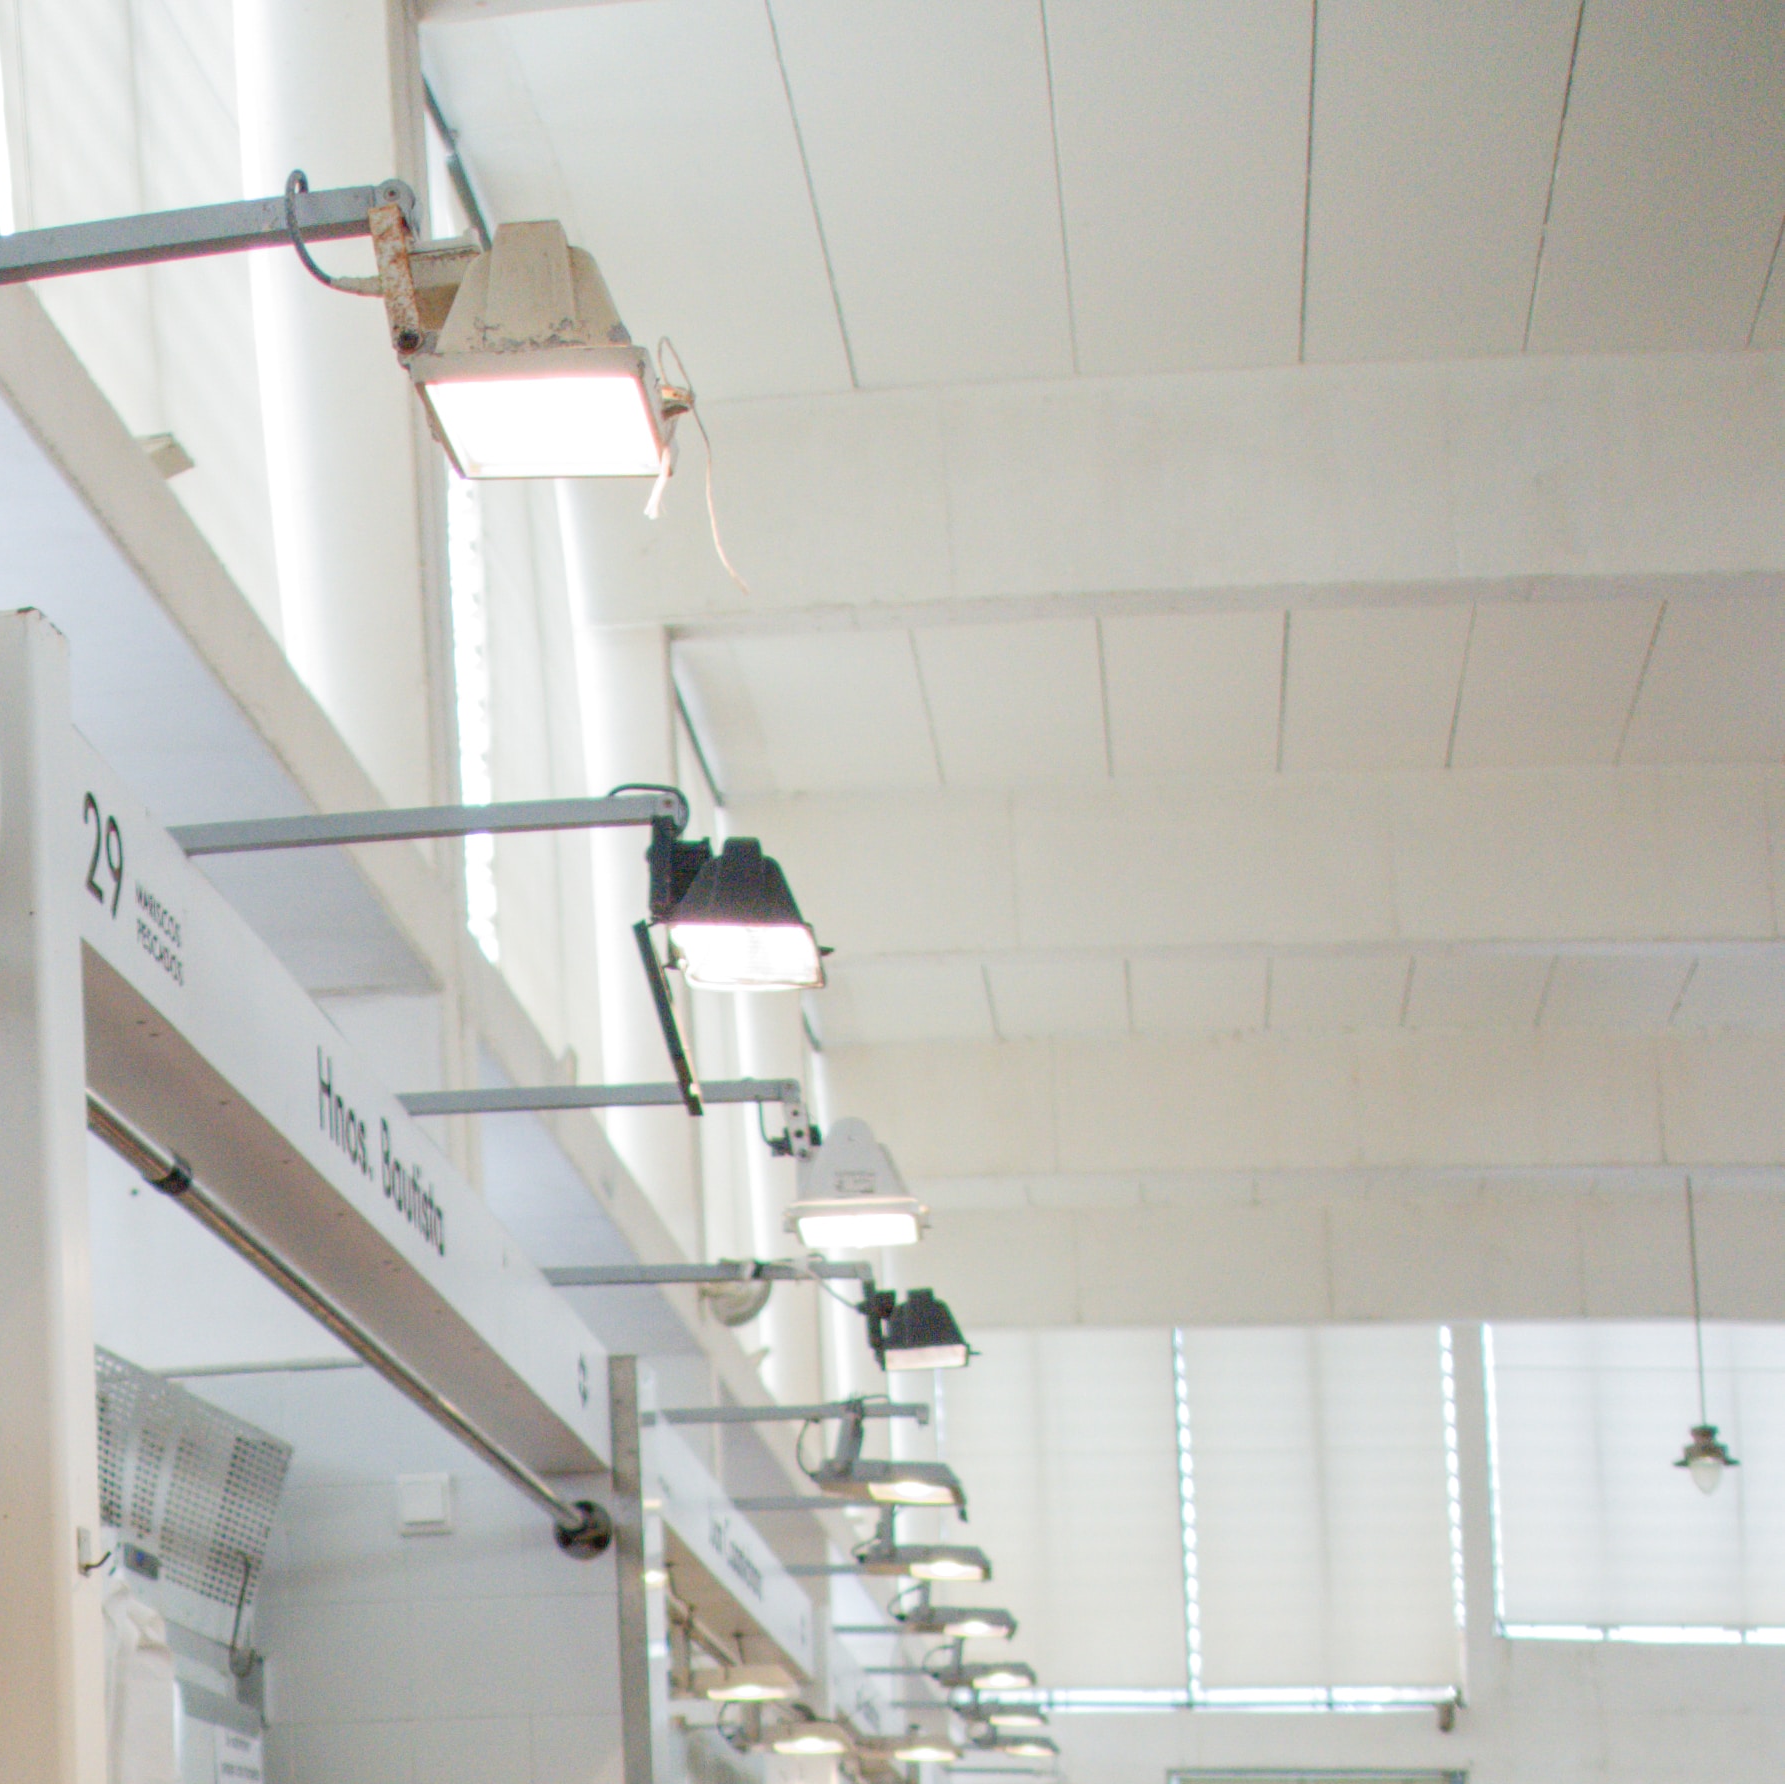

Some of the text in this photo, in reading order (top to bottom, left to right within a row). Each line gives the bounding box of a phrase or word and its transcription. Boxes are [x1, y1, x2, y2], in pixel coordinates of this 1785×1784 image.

[83, 791, 123, 919] 29
[135, 880, 182, 948] MARISCOS
[137, 917, 184, 987] PESCADOS
[317, 1044, 374, 1181] Hnos.
[380, 1116, 446, 1257] Bautista
